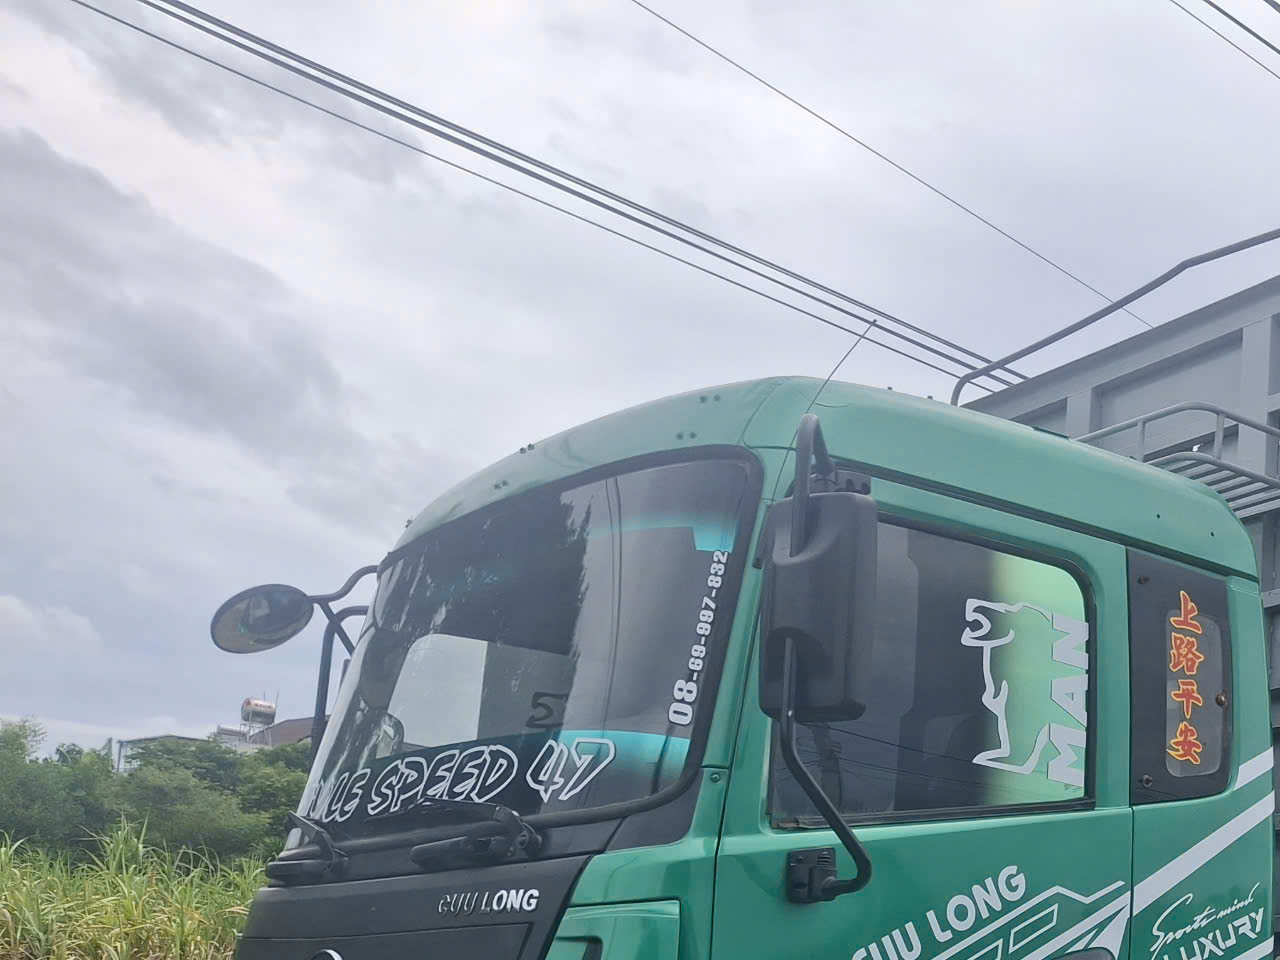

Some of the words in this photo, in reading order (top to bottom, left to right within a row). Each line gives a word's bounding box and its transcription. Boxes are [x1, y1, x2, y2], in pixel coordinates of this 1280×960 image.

[668, 550, 728, 726] 08-69-997-832
[1047, 612, 1089, 788] MAN
[1165, 590, 1204, 765] 上路平安
[367, 745, 518, 815] SPEED
[526, 737, 616, 804] 47
[480, 888, 540, 914] LONG
[926, 865, 1026, 943] LONG
